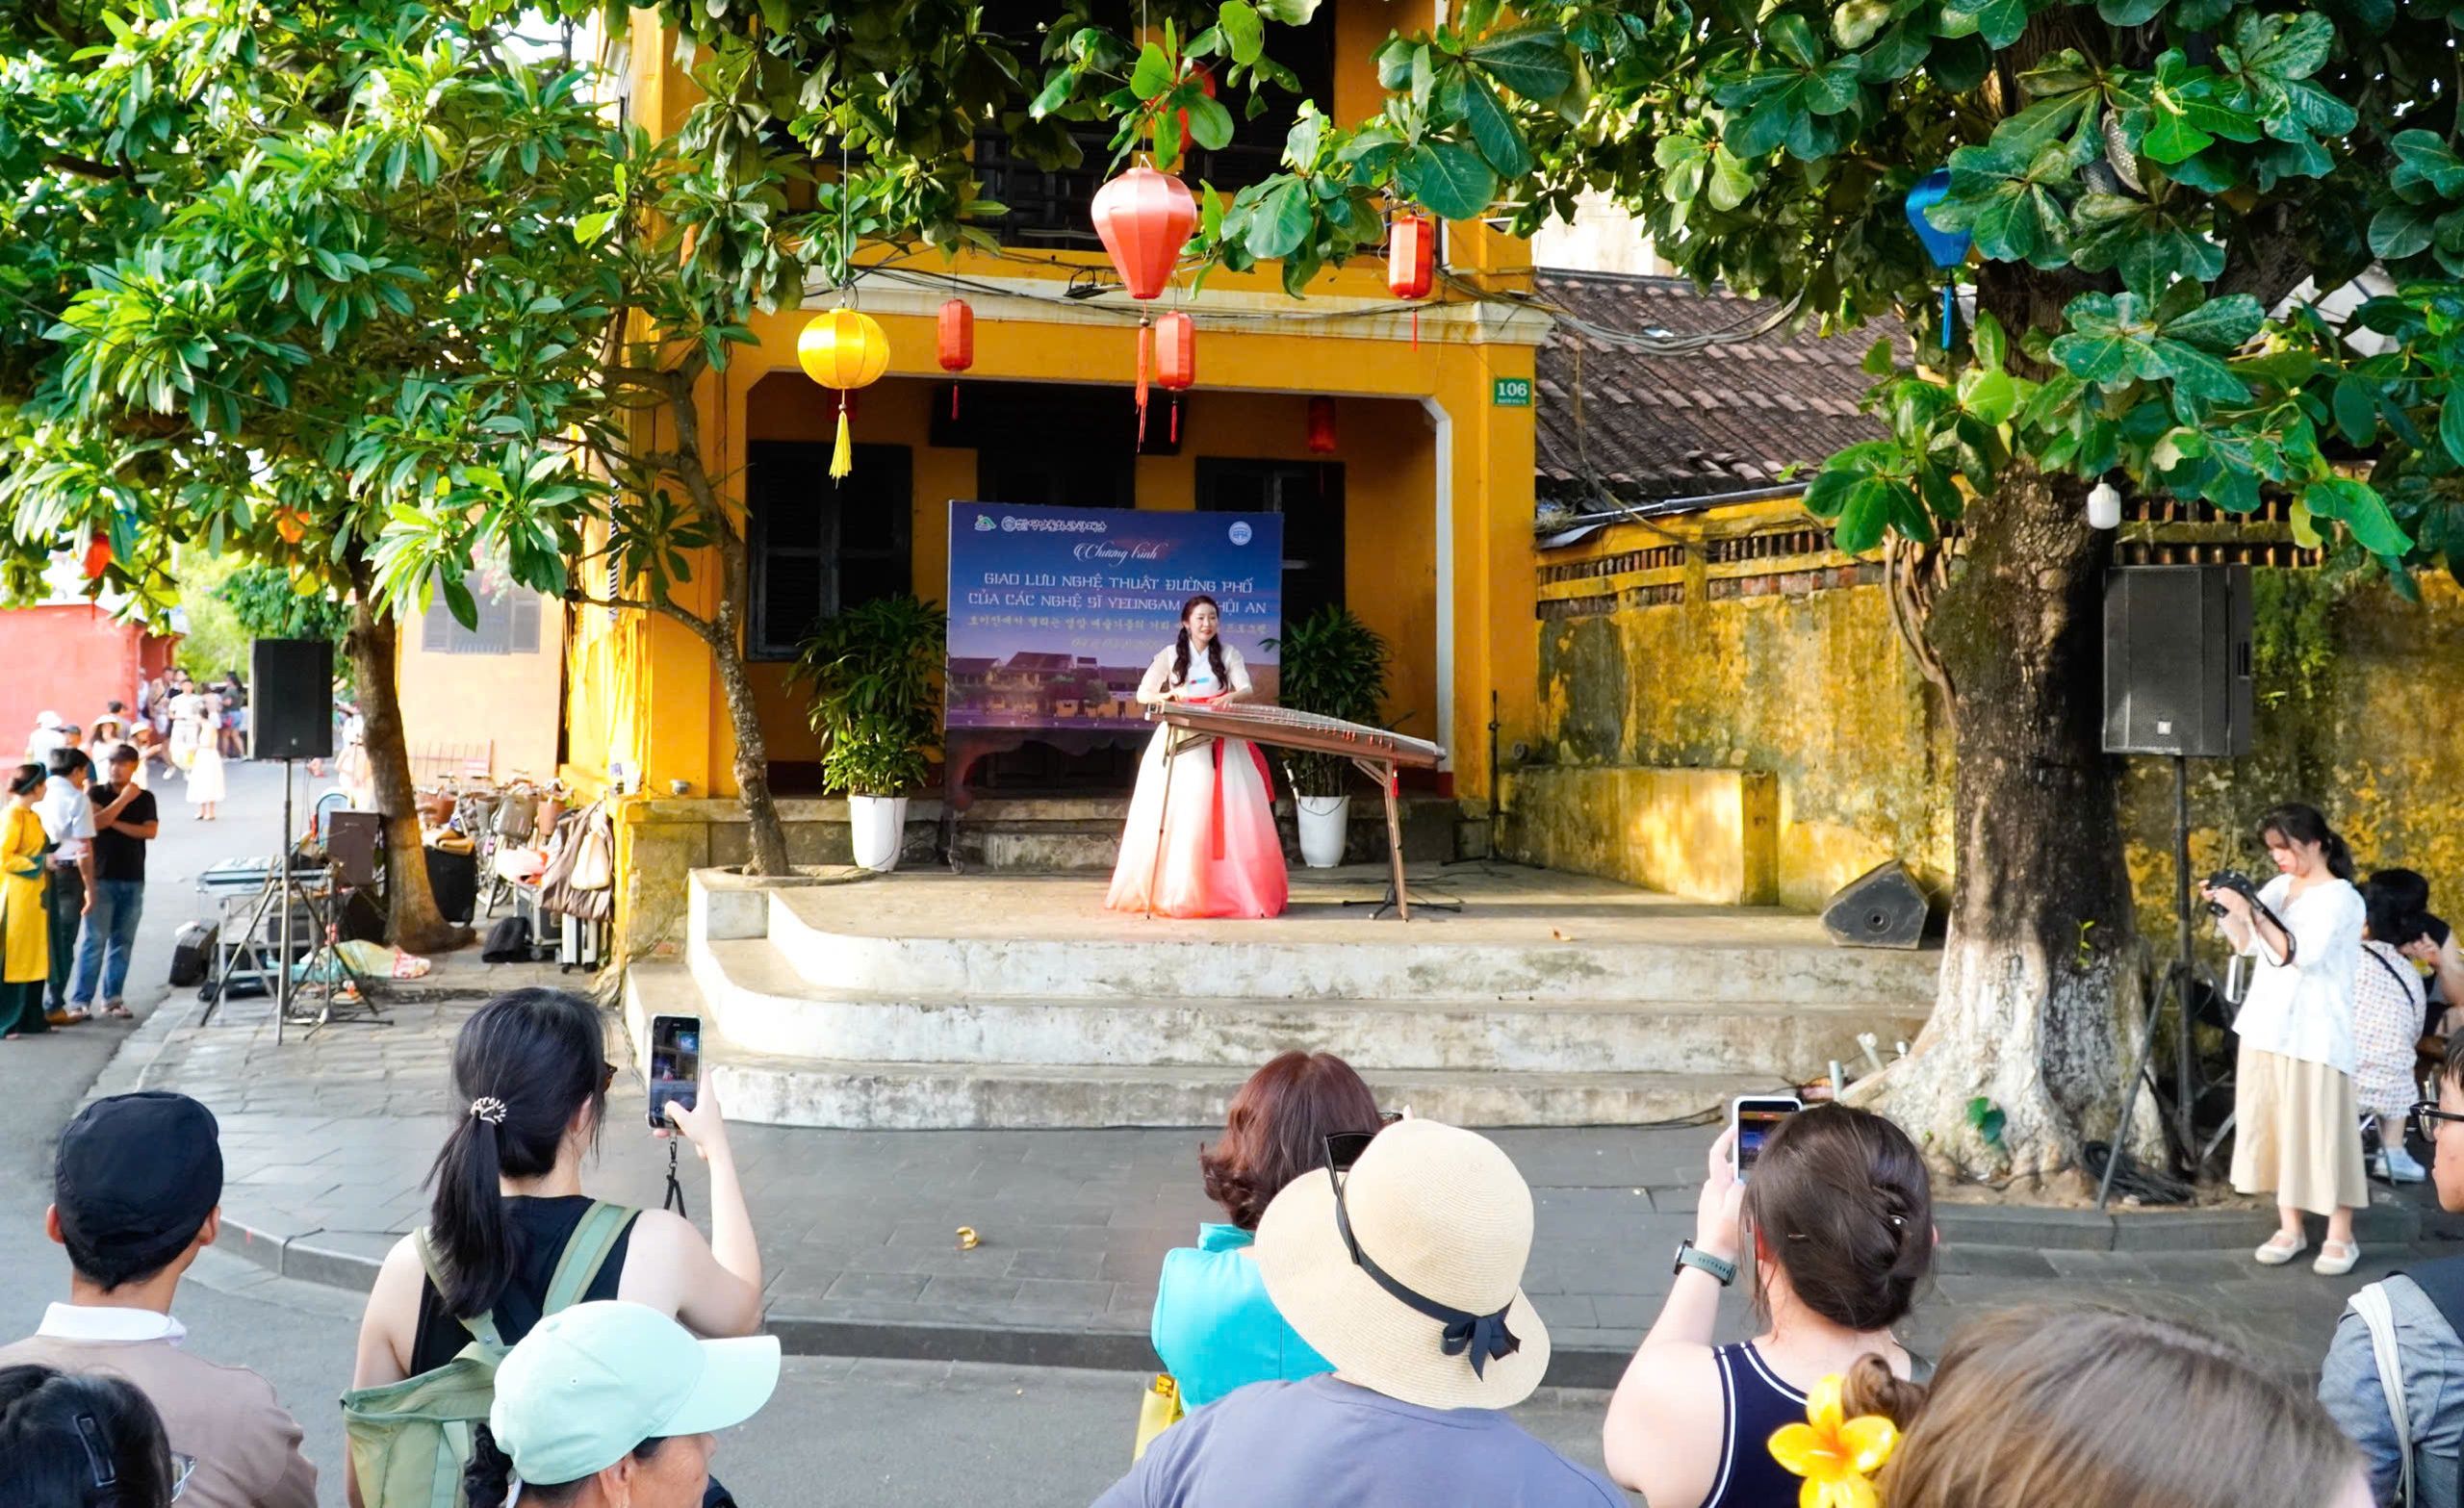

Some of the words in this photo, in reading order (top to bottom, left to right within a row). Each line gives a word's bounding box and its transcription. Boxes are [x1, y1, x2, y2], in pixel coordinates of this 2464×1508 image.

[1498, 382, 1528, 396] 106
[984, 573, 1019, 586] GIAO
[1025, 573, 1056, 587] LƯU
[1062, 573, 1103, 591] NGHỆ
[1109, 575, 1159, 593] THUẬT
[1166, 575, 1216, 593] ĐƯỜNG
[1221, 576, 1254, 594] PHỐ
[968, 588, 1000, 605] CỦA
[1005, 590, 1035, 606] CÁC
[1040, 593, 1083, 611] NGHỆ
[1245, 601, 1267, 613] AN
